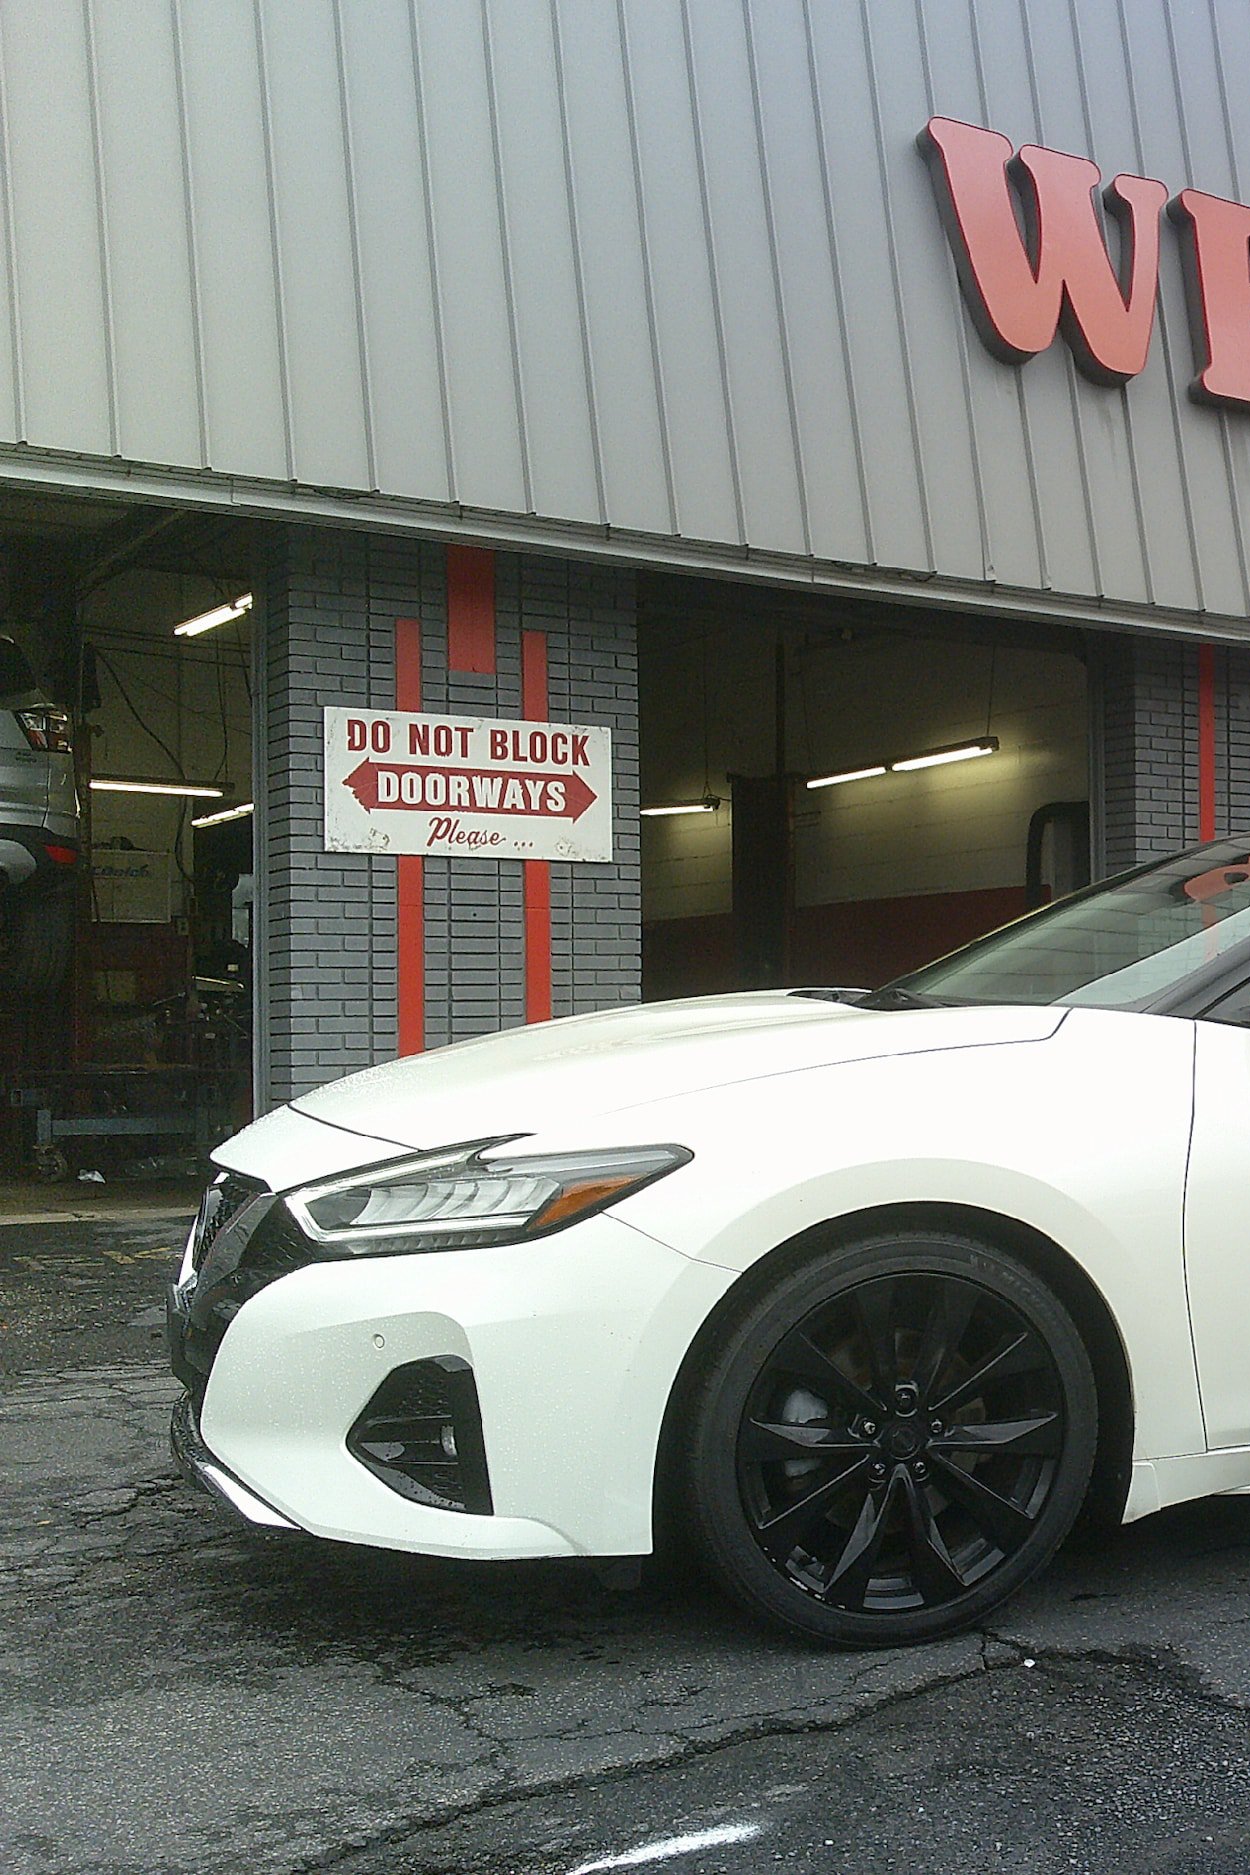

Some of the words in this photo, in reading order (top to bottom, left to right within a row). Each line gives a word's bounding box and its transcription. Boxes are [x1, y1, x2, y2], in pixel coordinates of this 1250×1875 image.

[347, 719, 391, 753] DO
[409, 723, 474, 758] NOT
[490, 729, 590, 767] BLOCK
[377, 770, 567, 812] DOORWAYS
[426, 816, 506, 848] Please
